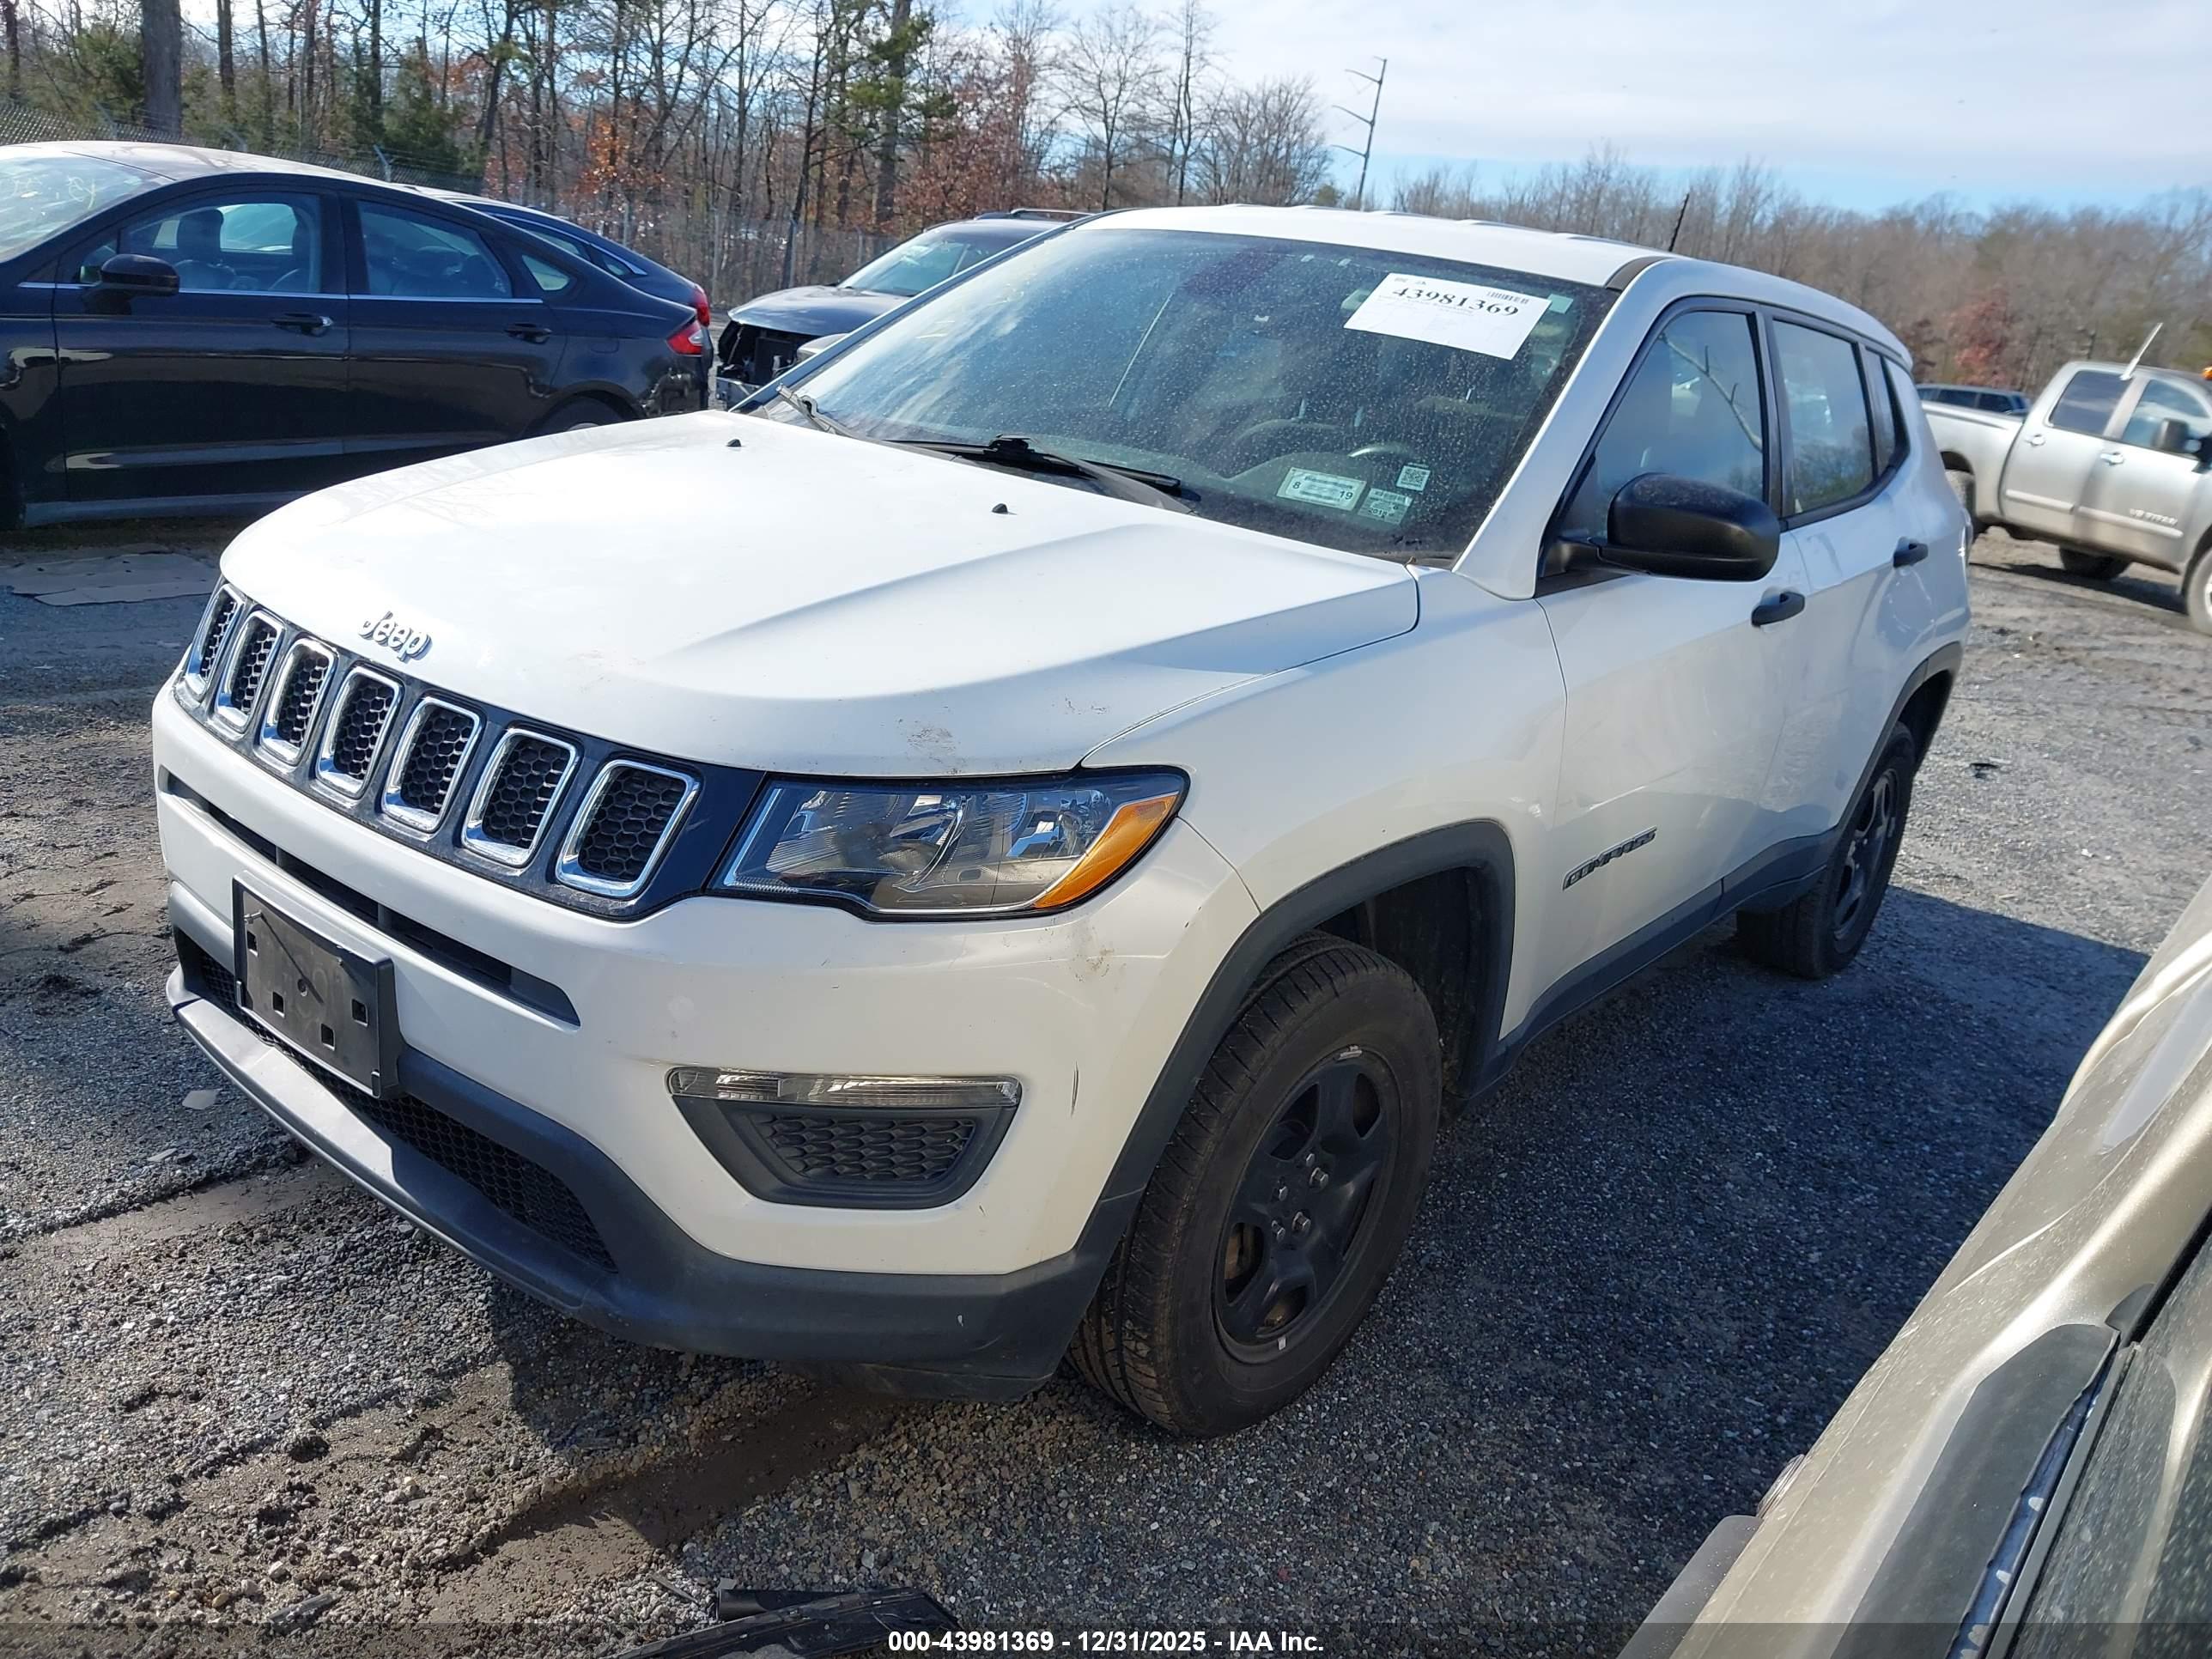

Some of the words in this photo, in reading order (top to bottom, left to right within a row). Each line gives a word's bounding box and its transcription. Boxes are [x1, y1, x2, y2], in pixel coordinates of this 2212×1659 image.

[1392, 287, 1520, 317] 43981369
[1339, 489, 1353, 501] 19
[358, 611, 433, 665] Jeep
